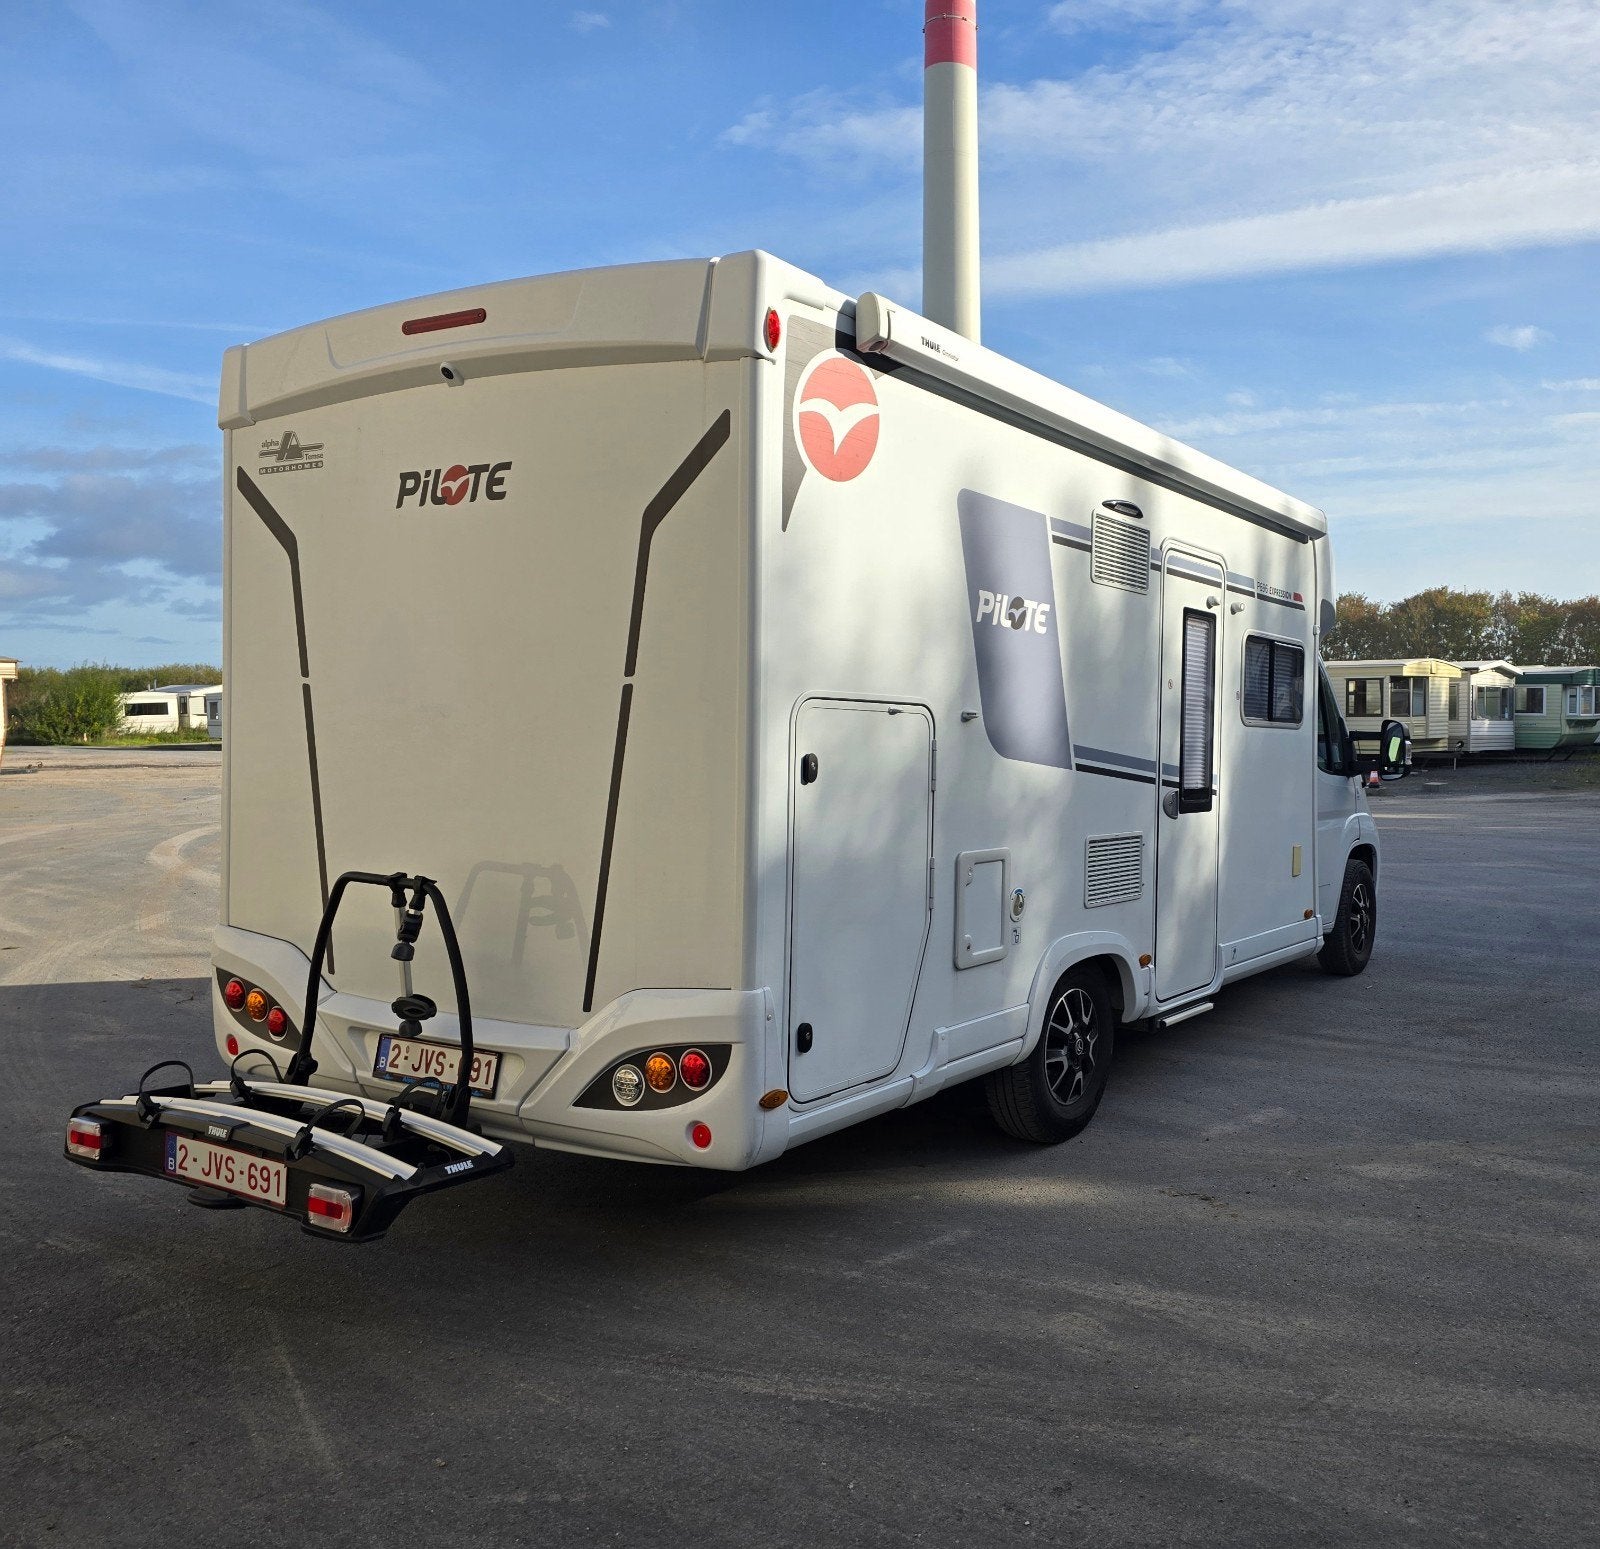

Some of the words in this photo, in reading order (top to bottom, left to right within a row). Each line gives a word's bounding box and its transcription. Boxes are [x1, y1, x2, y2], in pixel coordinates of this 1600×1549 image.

[921, 336, 941, 353] THULE
[261, 439, 280, 449] alpha
[259, 461, 324, 474] MOTORHOMES
[379, 1056, 386, 1068] B
[389, 1043, 493, 1085] 2-JVS-91
[208, 1125, 228, 1138] THULE
[168, 1157, 175, 1171] B
[444, 1159, 474, 1175] THULE
